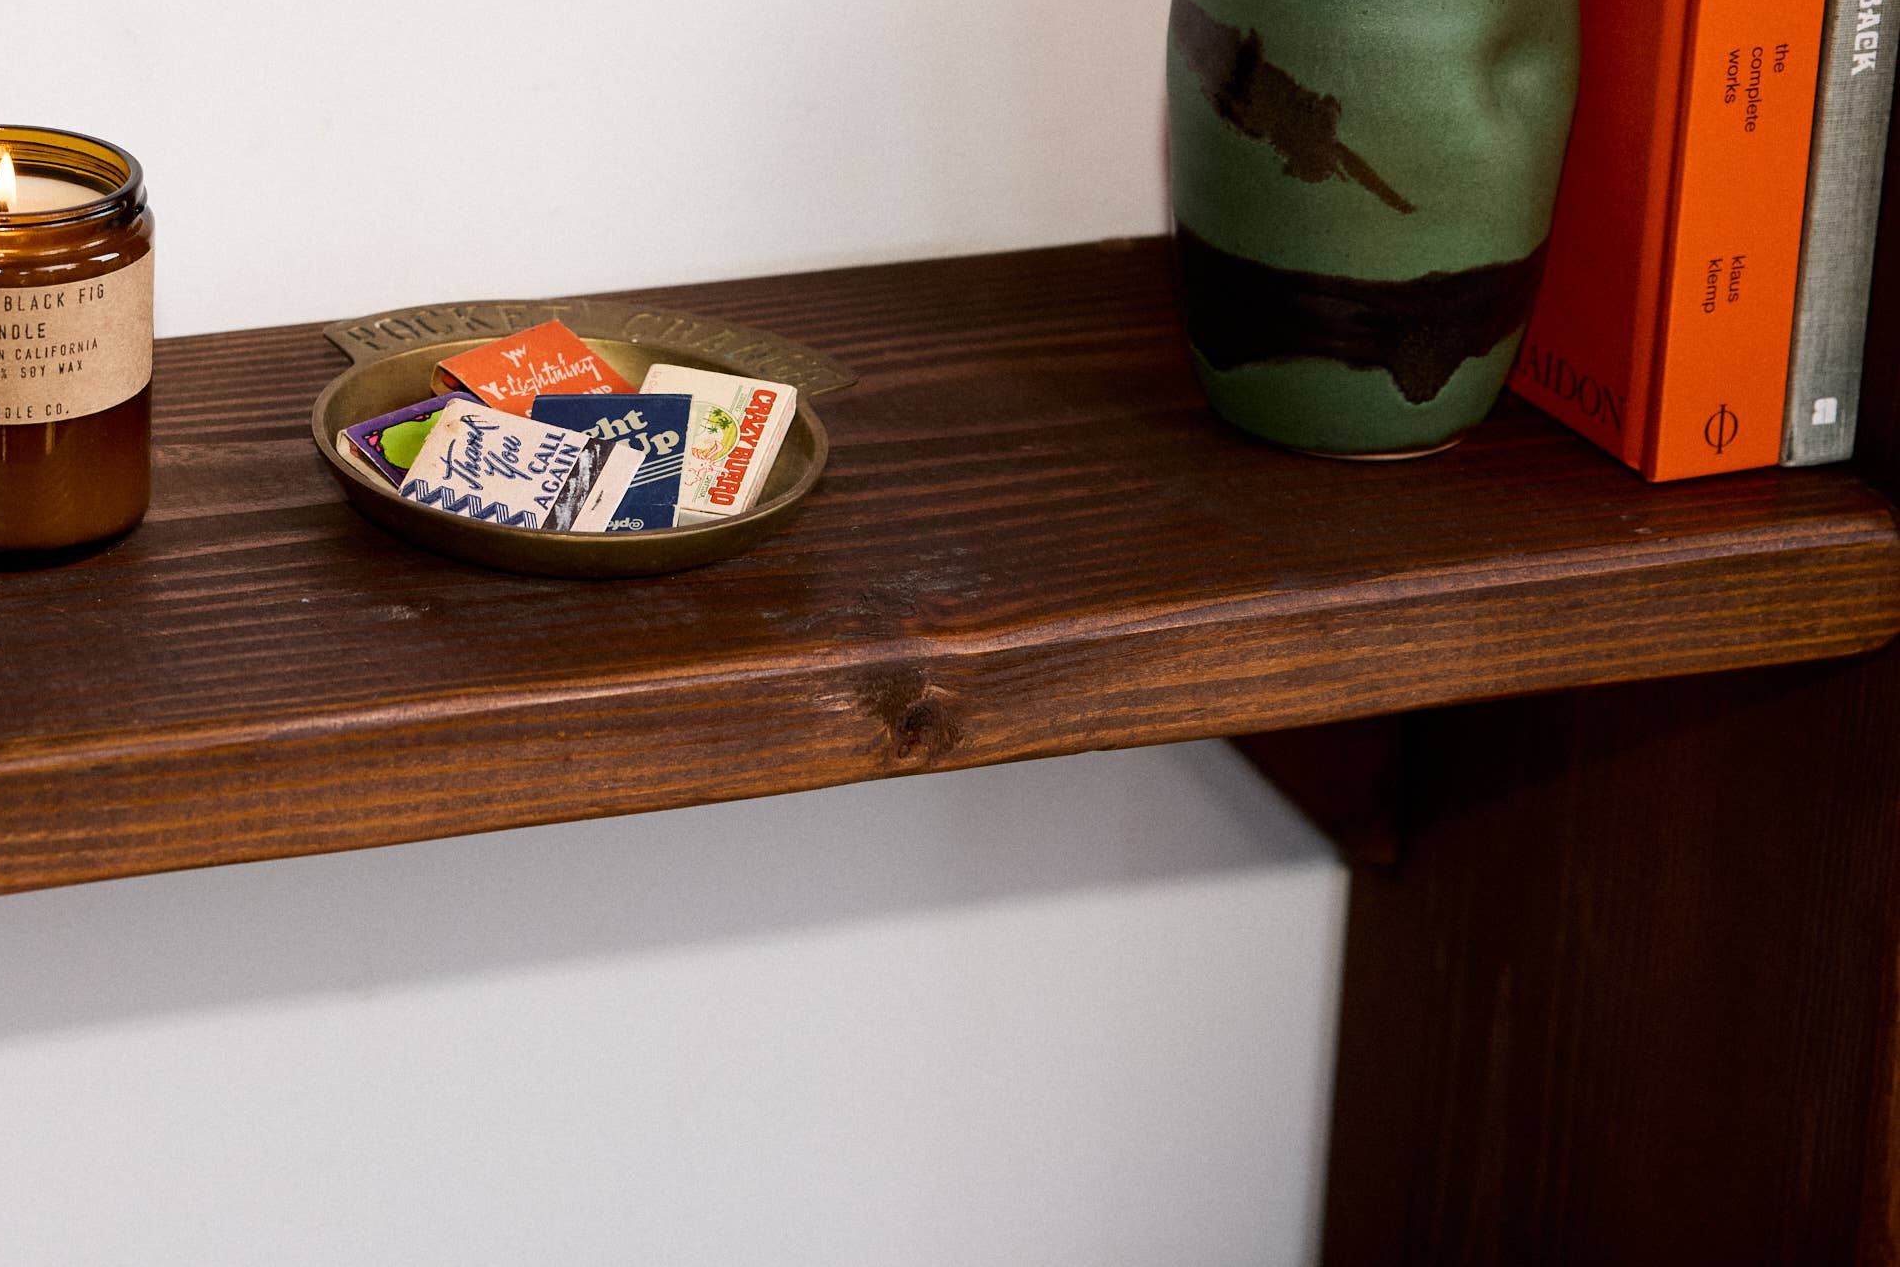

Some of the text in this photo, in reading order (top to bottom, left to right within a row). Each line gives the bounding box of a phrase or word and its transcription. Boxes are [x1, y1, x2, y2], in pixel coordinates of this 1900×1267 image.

[1724, 48, 1741, 105] works
[1773, 43, 1790, 74] the
[1745, 46, 1764, 134] complete
[4, 292, 65, 312] BLACK
[79, 283, 105, 305] FIG
[1703, 257, 1723, 315] klemp
[1727, 254, 1747, 304] klaus
[15, 337, 99, 361] CALIFORNIA
[20, 364, 46, 379] SOY
[58, 359, 83, 374] WAX
[45, 402, 71, 417] CO.
[740, 389, 777, 449] CRAZY
[440, 415, 500, 491] Thank
[483, 435, 533, 481] You
[528, 432, 566, 474] CALL
[534, 443, 581, 510] AGAIN
